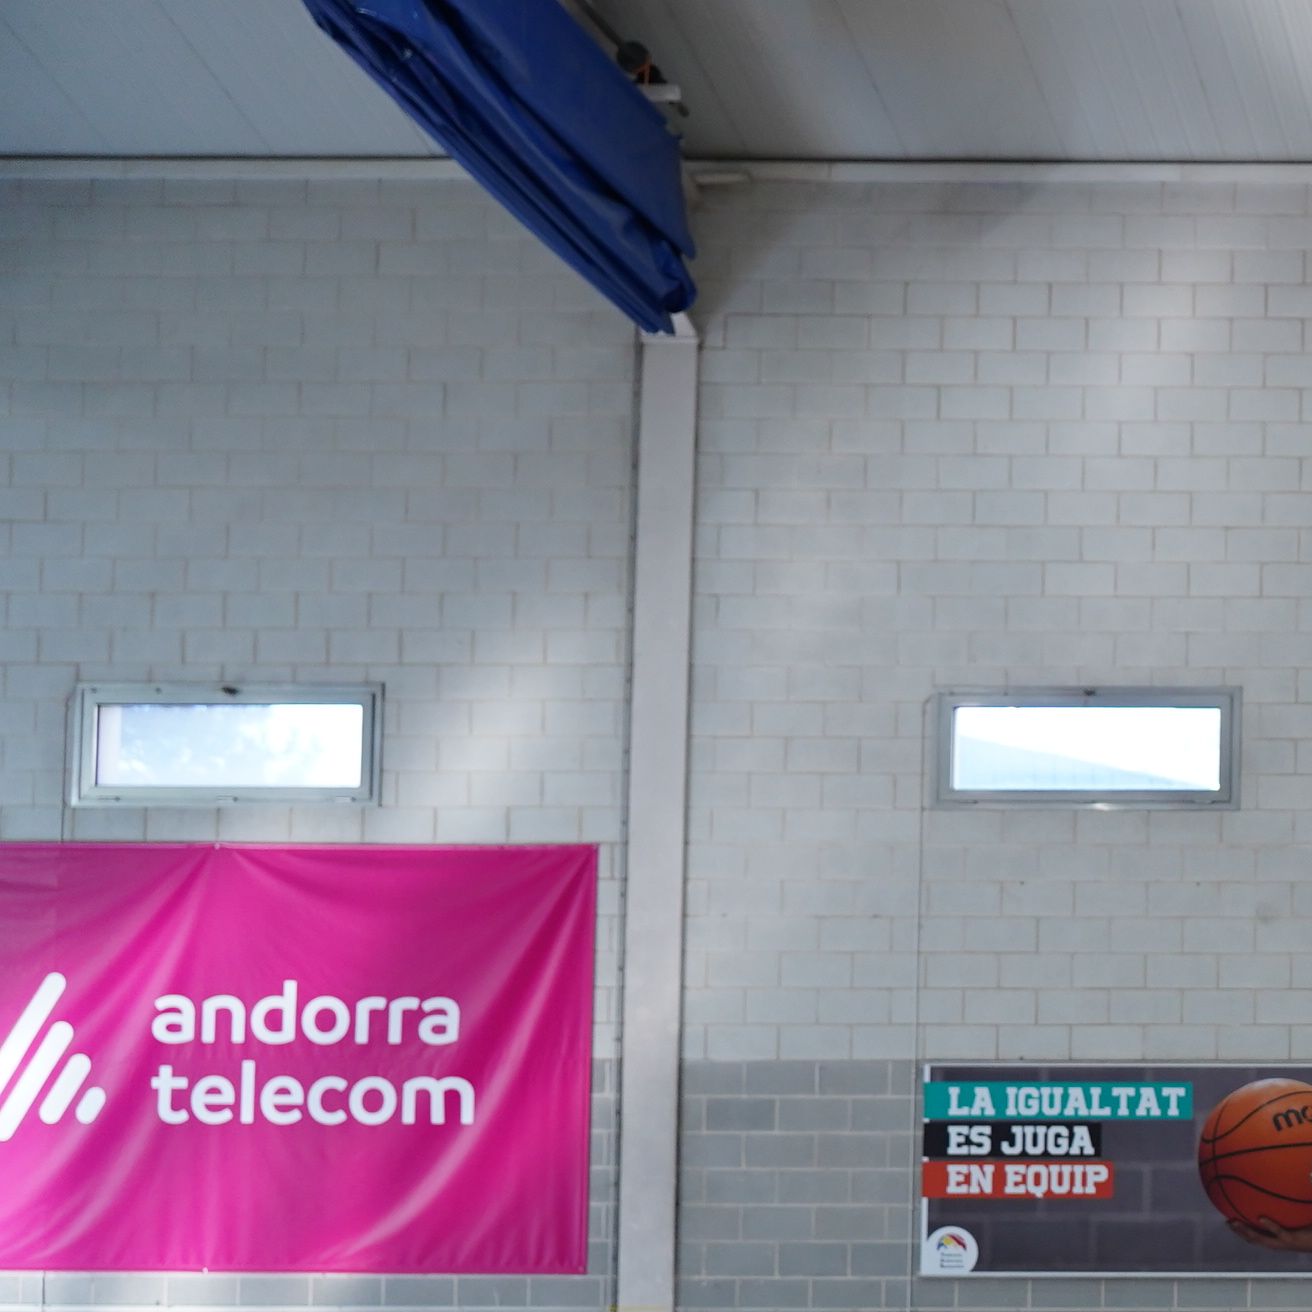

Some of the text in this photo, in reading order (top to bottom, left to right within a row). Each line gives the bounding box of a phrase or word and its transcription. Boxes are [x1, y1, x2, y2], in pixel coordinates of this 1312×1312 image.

[151, 979, 460, 1045] andorra
[150, 1059, 475, 1126] telecom
[947, 1086, 1186, 1117] LA IGUALTAT
[947, 1125, 1095, 1155] ES JUGA
[946, 1164, 1109, 1199] EN EQUIP
